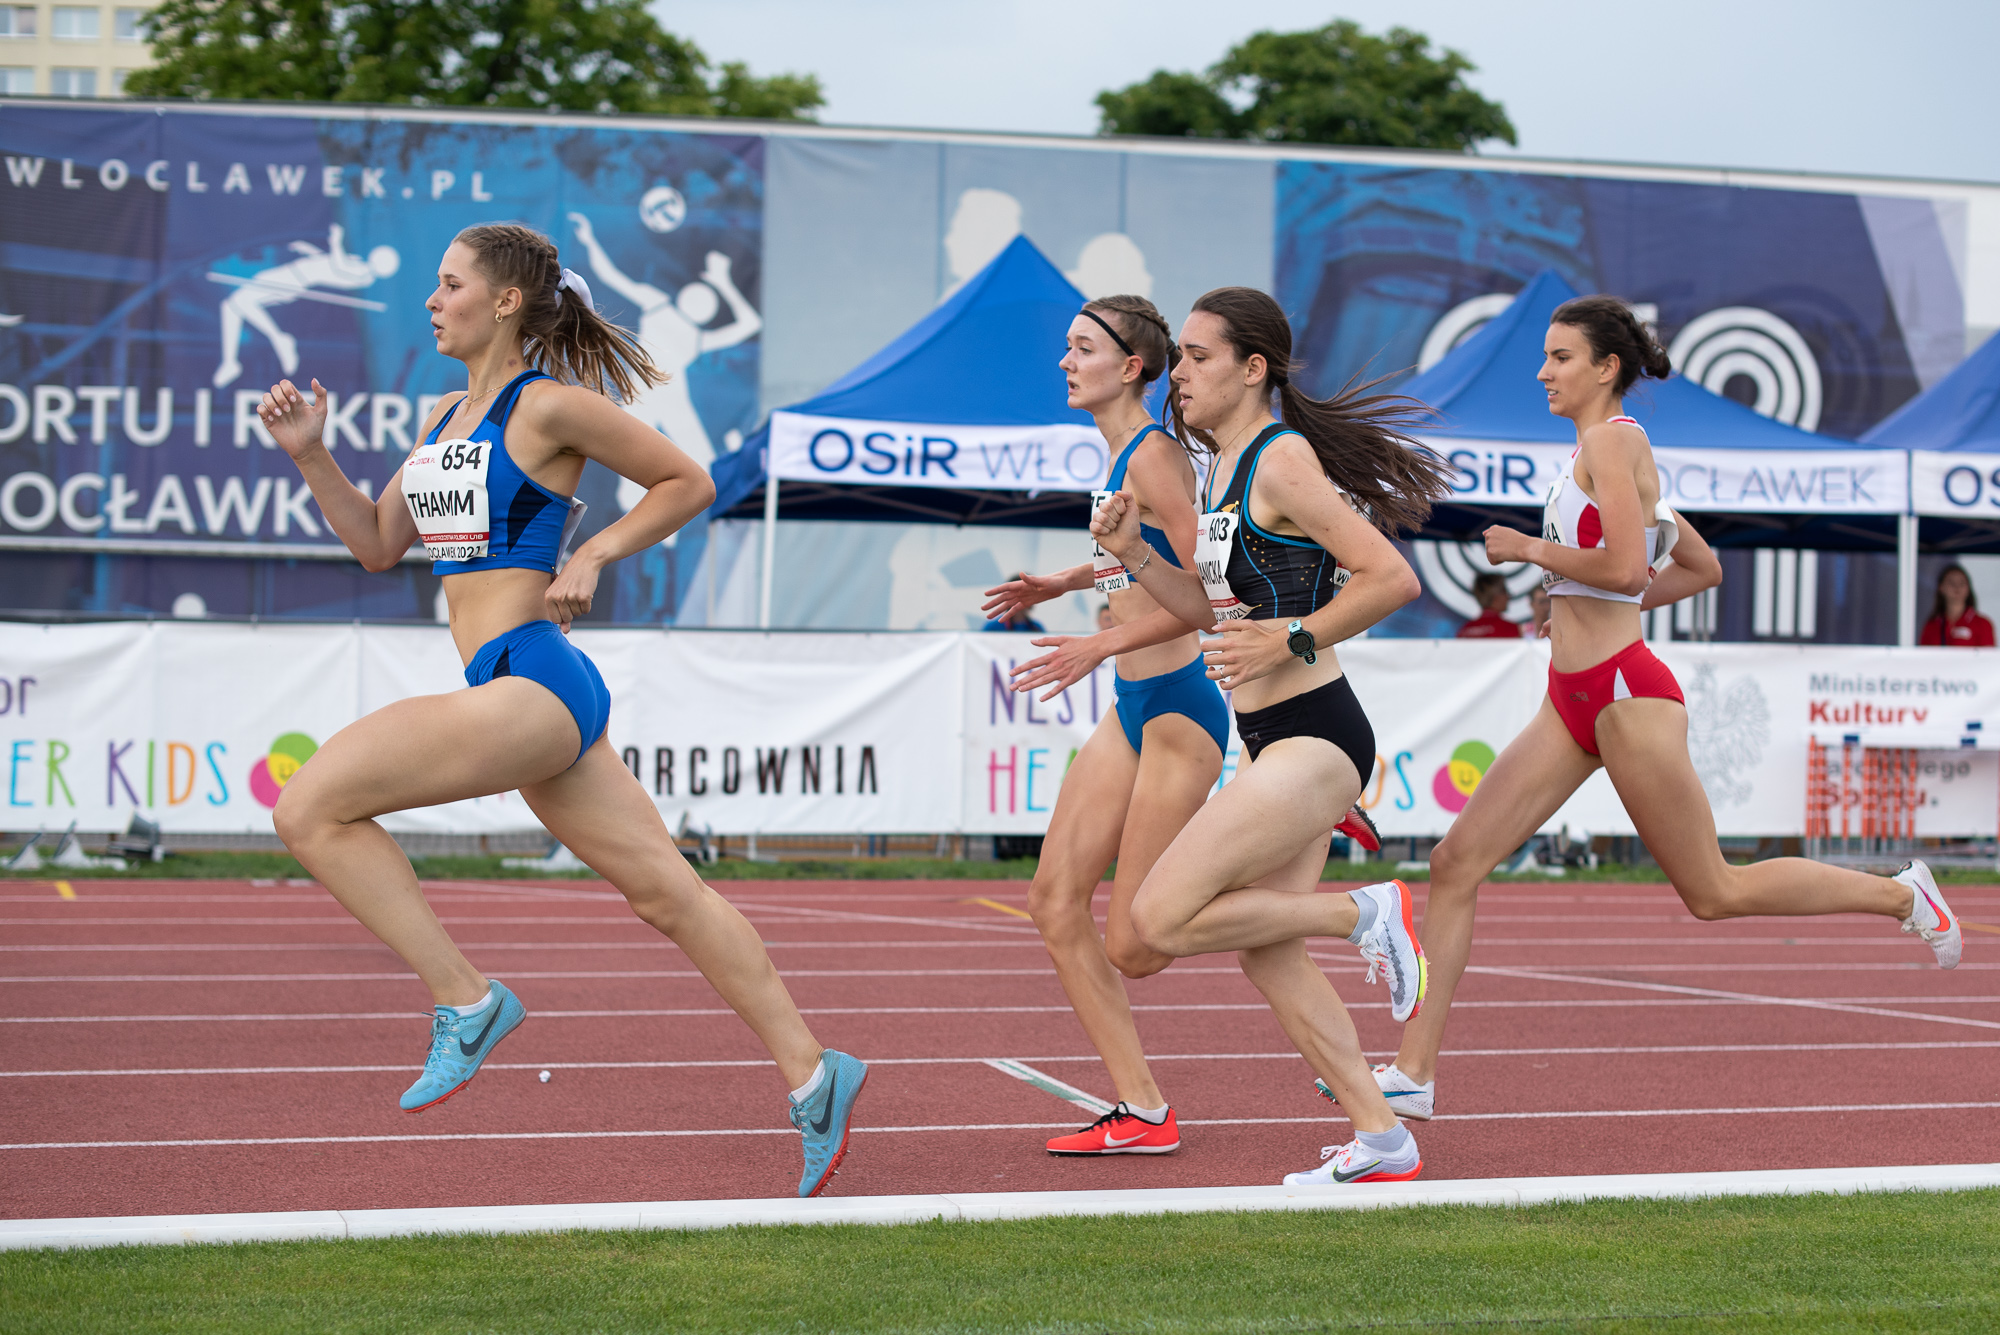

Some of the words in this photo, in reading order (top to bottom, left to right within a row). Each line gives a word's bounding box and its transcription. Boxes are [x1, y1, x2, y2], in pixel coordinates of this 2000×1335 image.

[3, 156, 493, 202] WLOCLAWEK.PL
[194, 388, 211, 448] I
[441, 444, 483, 471] 654
[808, 427, 959, 479] OSiR
[407, 489, 475, 518] THAMM
[1209, 517, 1231, 542] 603
[457, 545, 481, 559] 2021
[1107, 577, 1125, 590] 2021
[1196, 560, 1225, 586] ANICKA
[1809, 674, 1980, 696] Ministerstwo
[107, 738, 229, 809] KIDS
